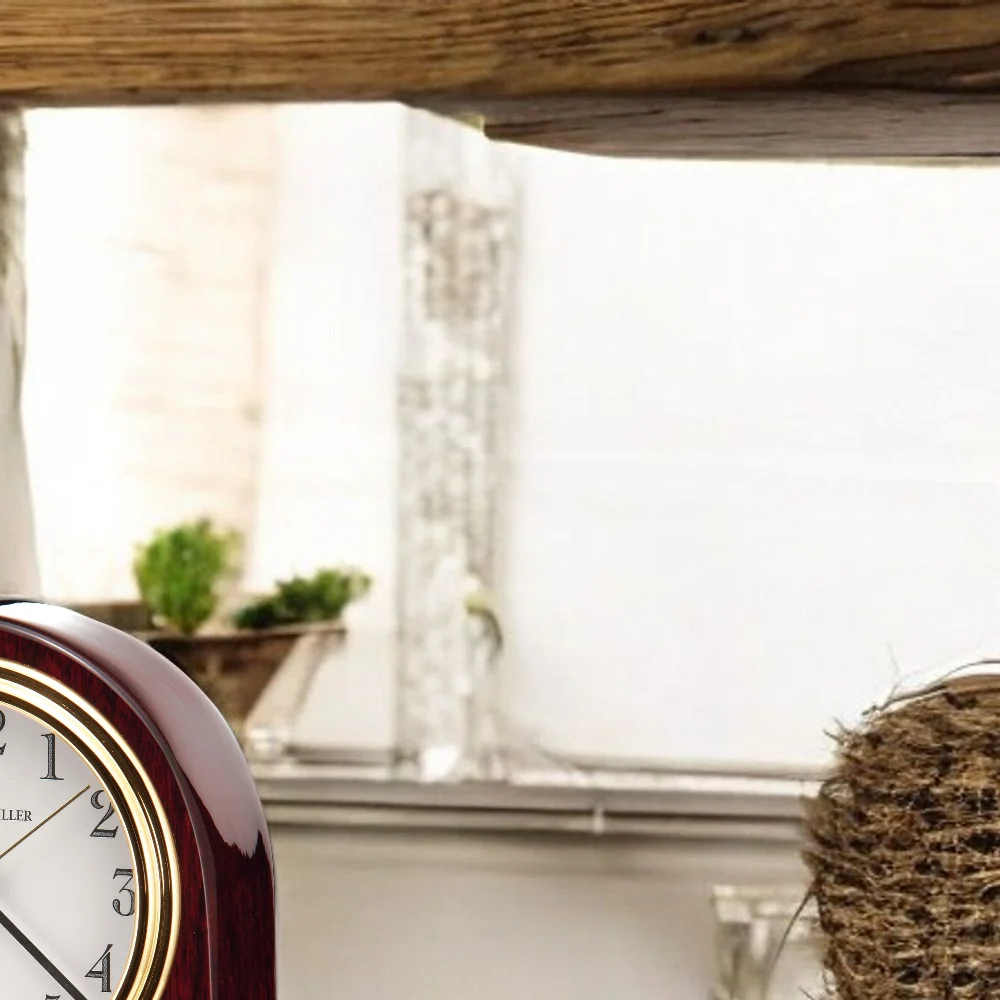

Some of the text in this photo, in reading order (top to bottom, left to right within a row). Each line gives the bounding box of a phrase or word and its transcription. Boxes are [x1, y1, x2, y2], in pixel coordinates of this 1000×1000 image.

[39, 732, 65, 781] 1
[89, 788, 119, 839] 2
[111, 867, 136, 917] 3
[83, 943, 114, 993] 4
